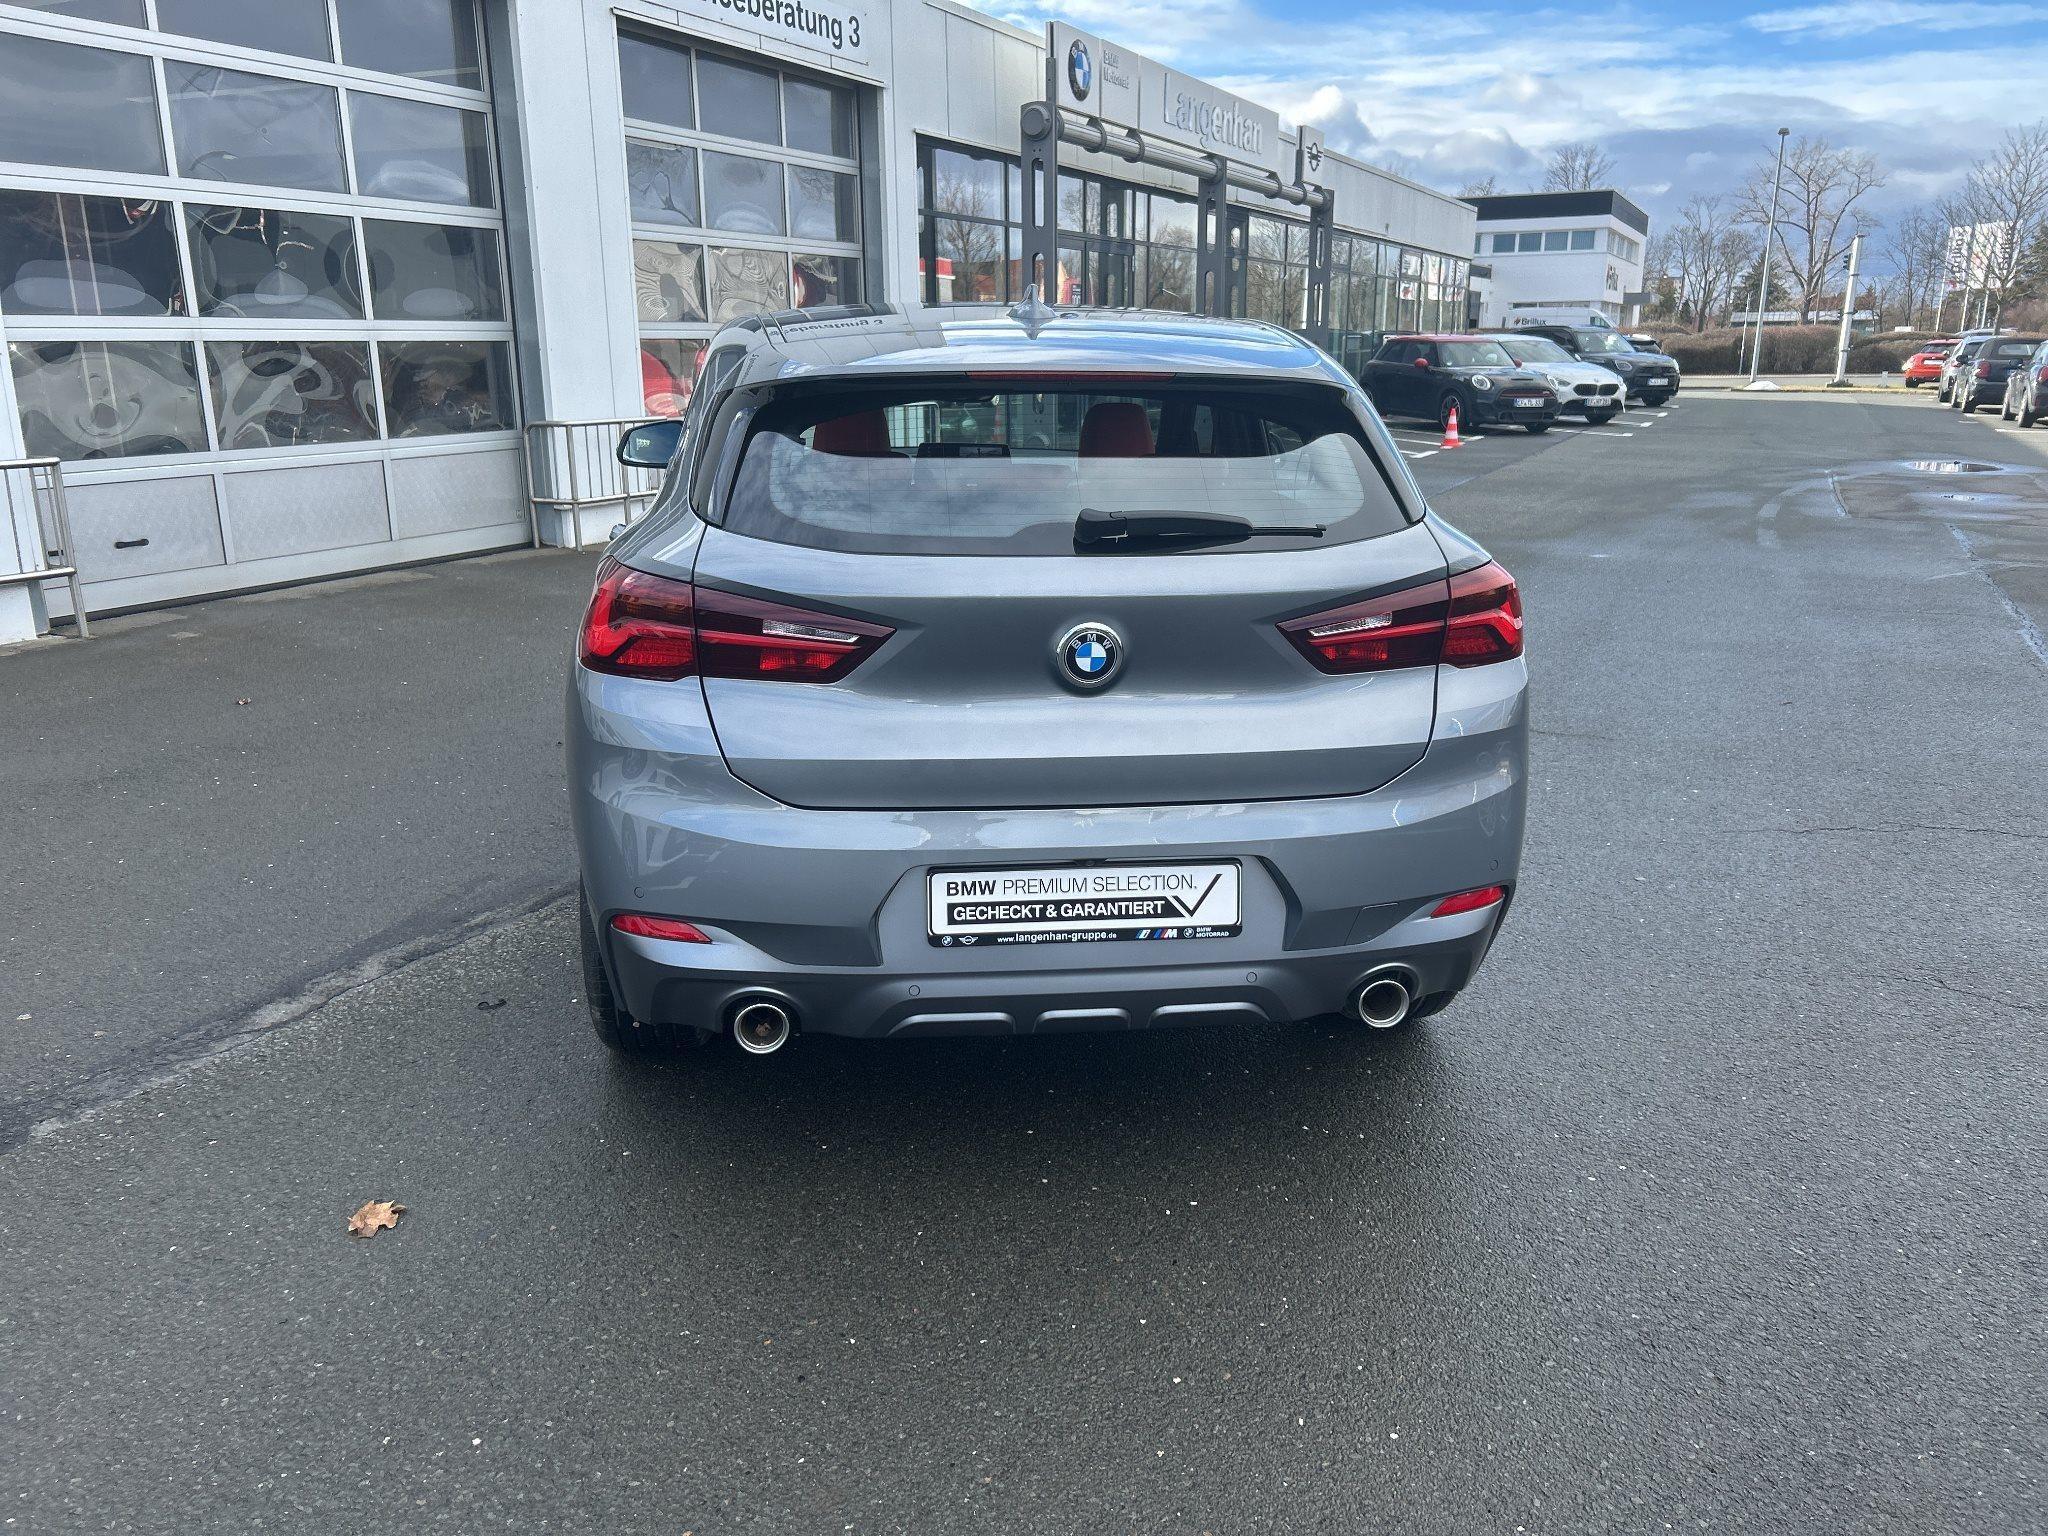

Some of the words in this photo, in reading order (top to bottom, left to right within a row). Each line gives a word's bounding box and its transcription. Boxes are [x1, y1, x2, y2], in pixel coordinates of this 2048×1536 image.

[711, 0, 842, 50] eberatung
[848, 16, 861, 48] 3
[1163, 72, 1264, 155] Langenhan
[1071, 633, 1112, 650] BMW
[946, 880, 996, 896] BMW
[1003, 877, 1087, 895] PREMIUM
[1093, 874, 1197, 893] SELECTION.
[953, 904, 1043, 921] GECHECKT
[1045, 904, 1058, 918] &
[1060, 900, 1166, 917] GARANTIERT
[997, 931, 1117, 944] www.langenhan-gruppe.de
